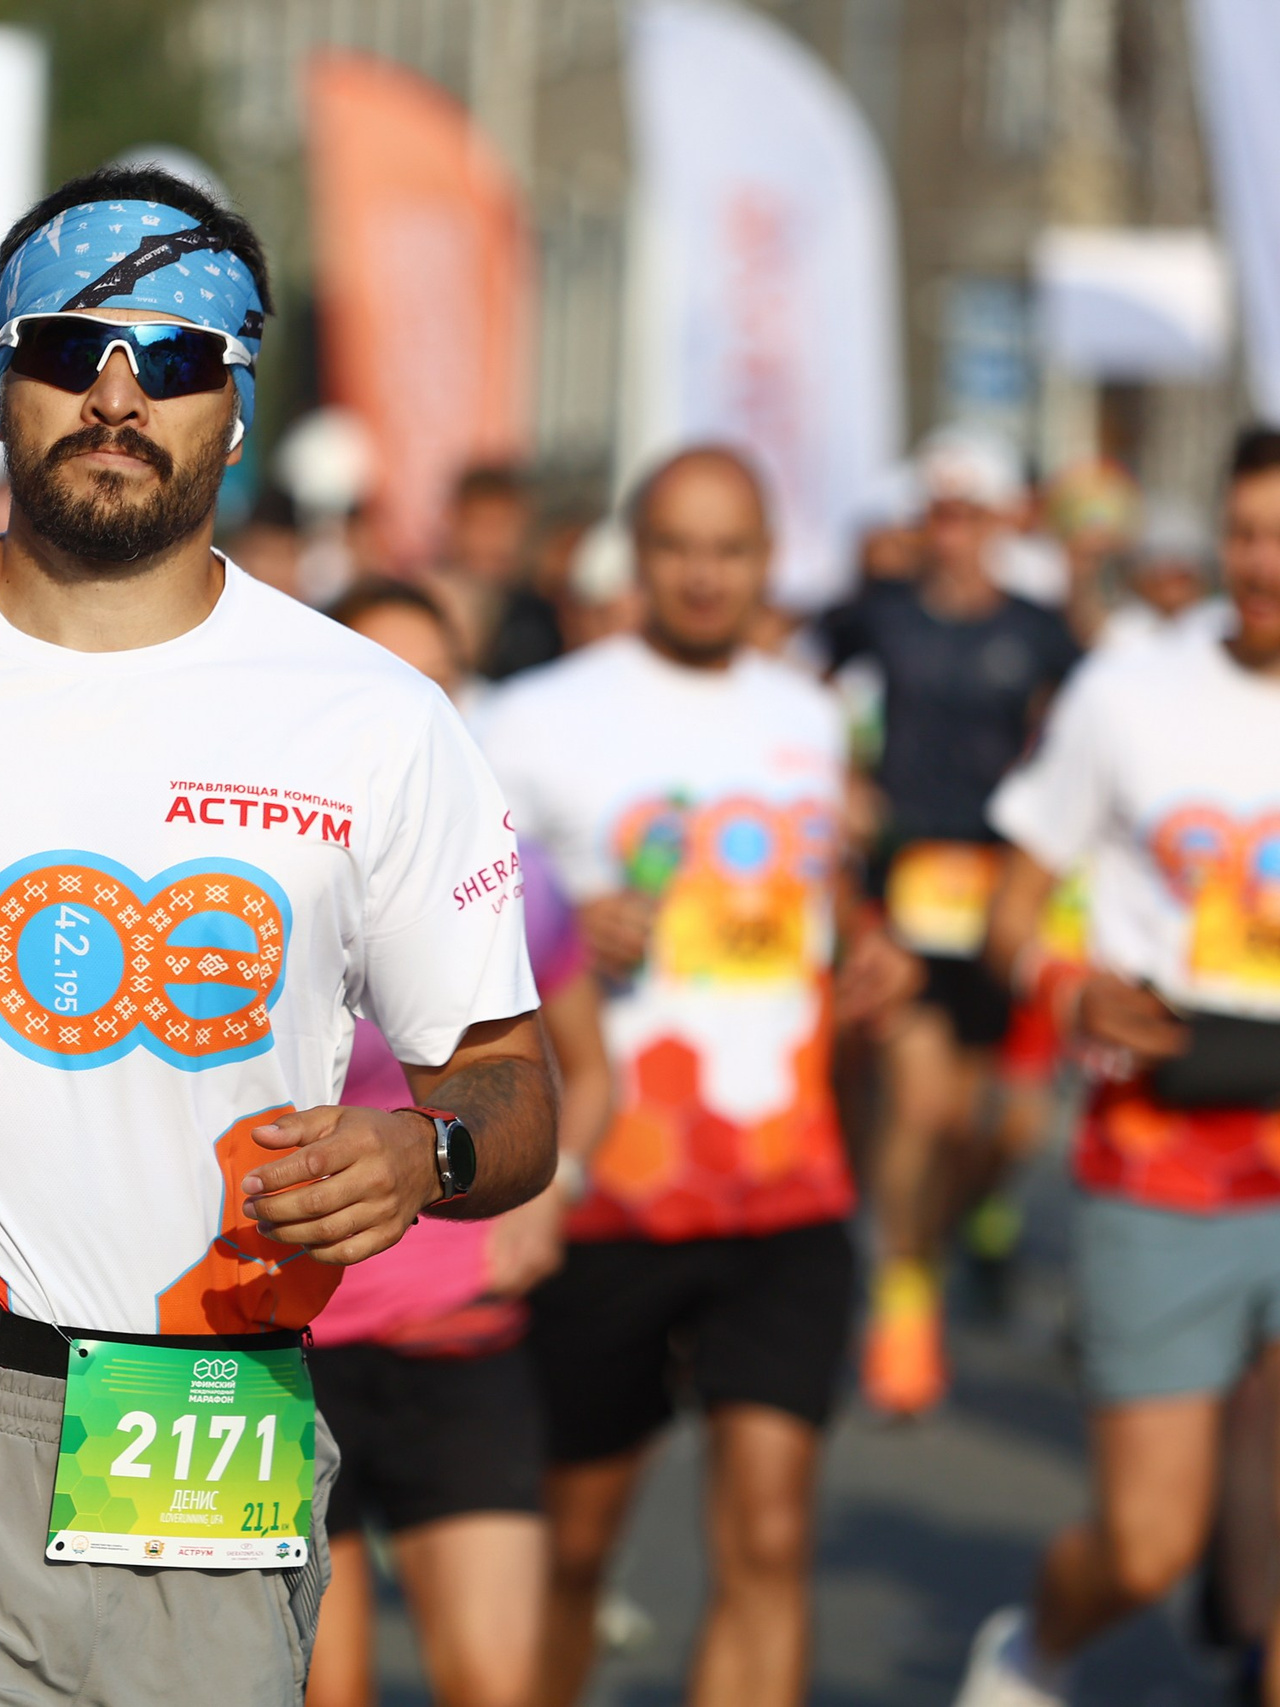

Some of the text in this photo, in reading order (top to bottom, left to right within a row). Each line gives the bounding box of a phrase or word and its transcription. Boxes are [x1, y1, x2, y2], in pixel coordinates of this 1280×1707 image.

[169, 780, 354, 815] УПРАВЛЯЮЩАЯ КОМПАНИЯ
[165, 796, 352, 848] АСТРУМ
[452, 851, 523, 911] SHERA
[54, 905, 91, 1012] 42.195
[188, 1395, 234, 1404] МАРАФОН
[190, 1380, 236, 1388] УФИМСКИЙ
[110, 1410, 276, 1482] 2171
[169, 1489, 219, 1512] ДЕНИС
[241, 1502, 280, 1538] 21,1
